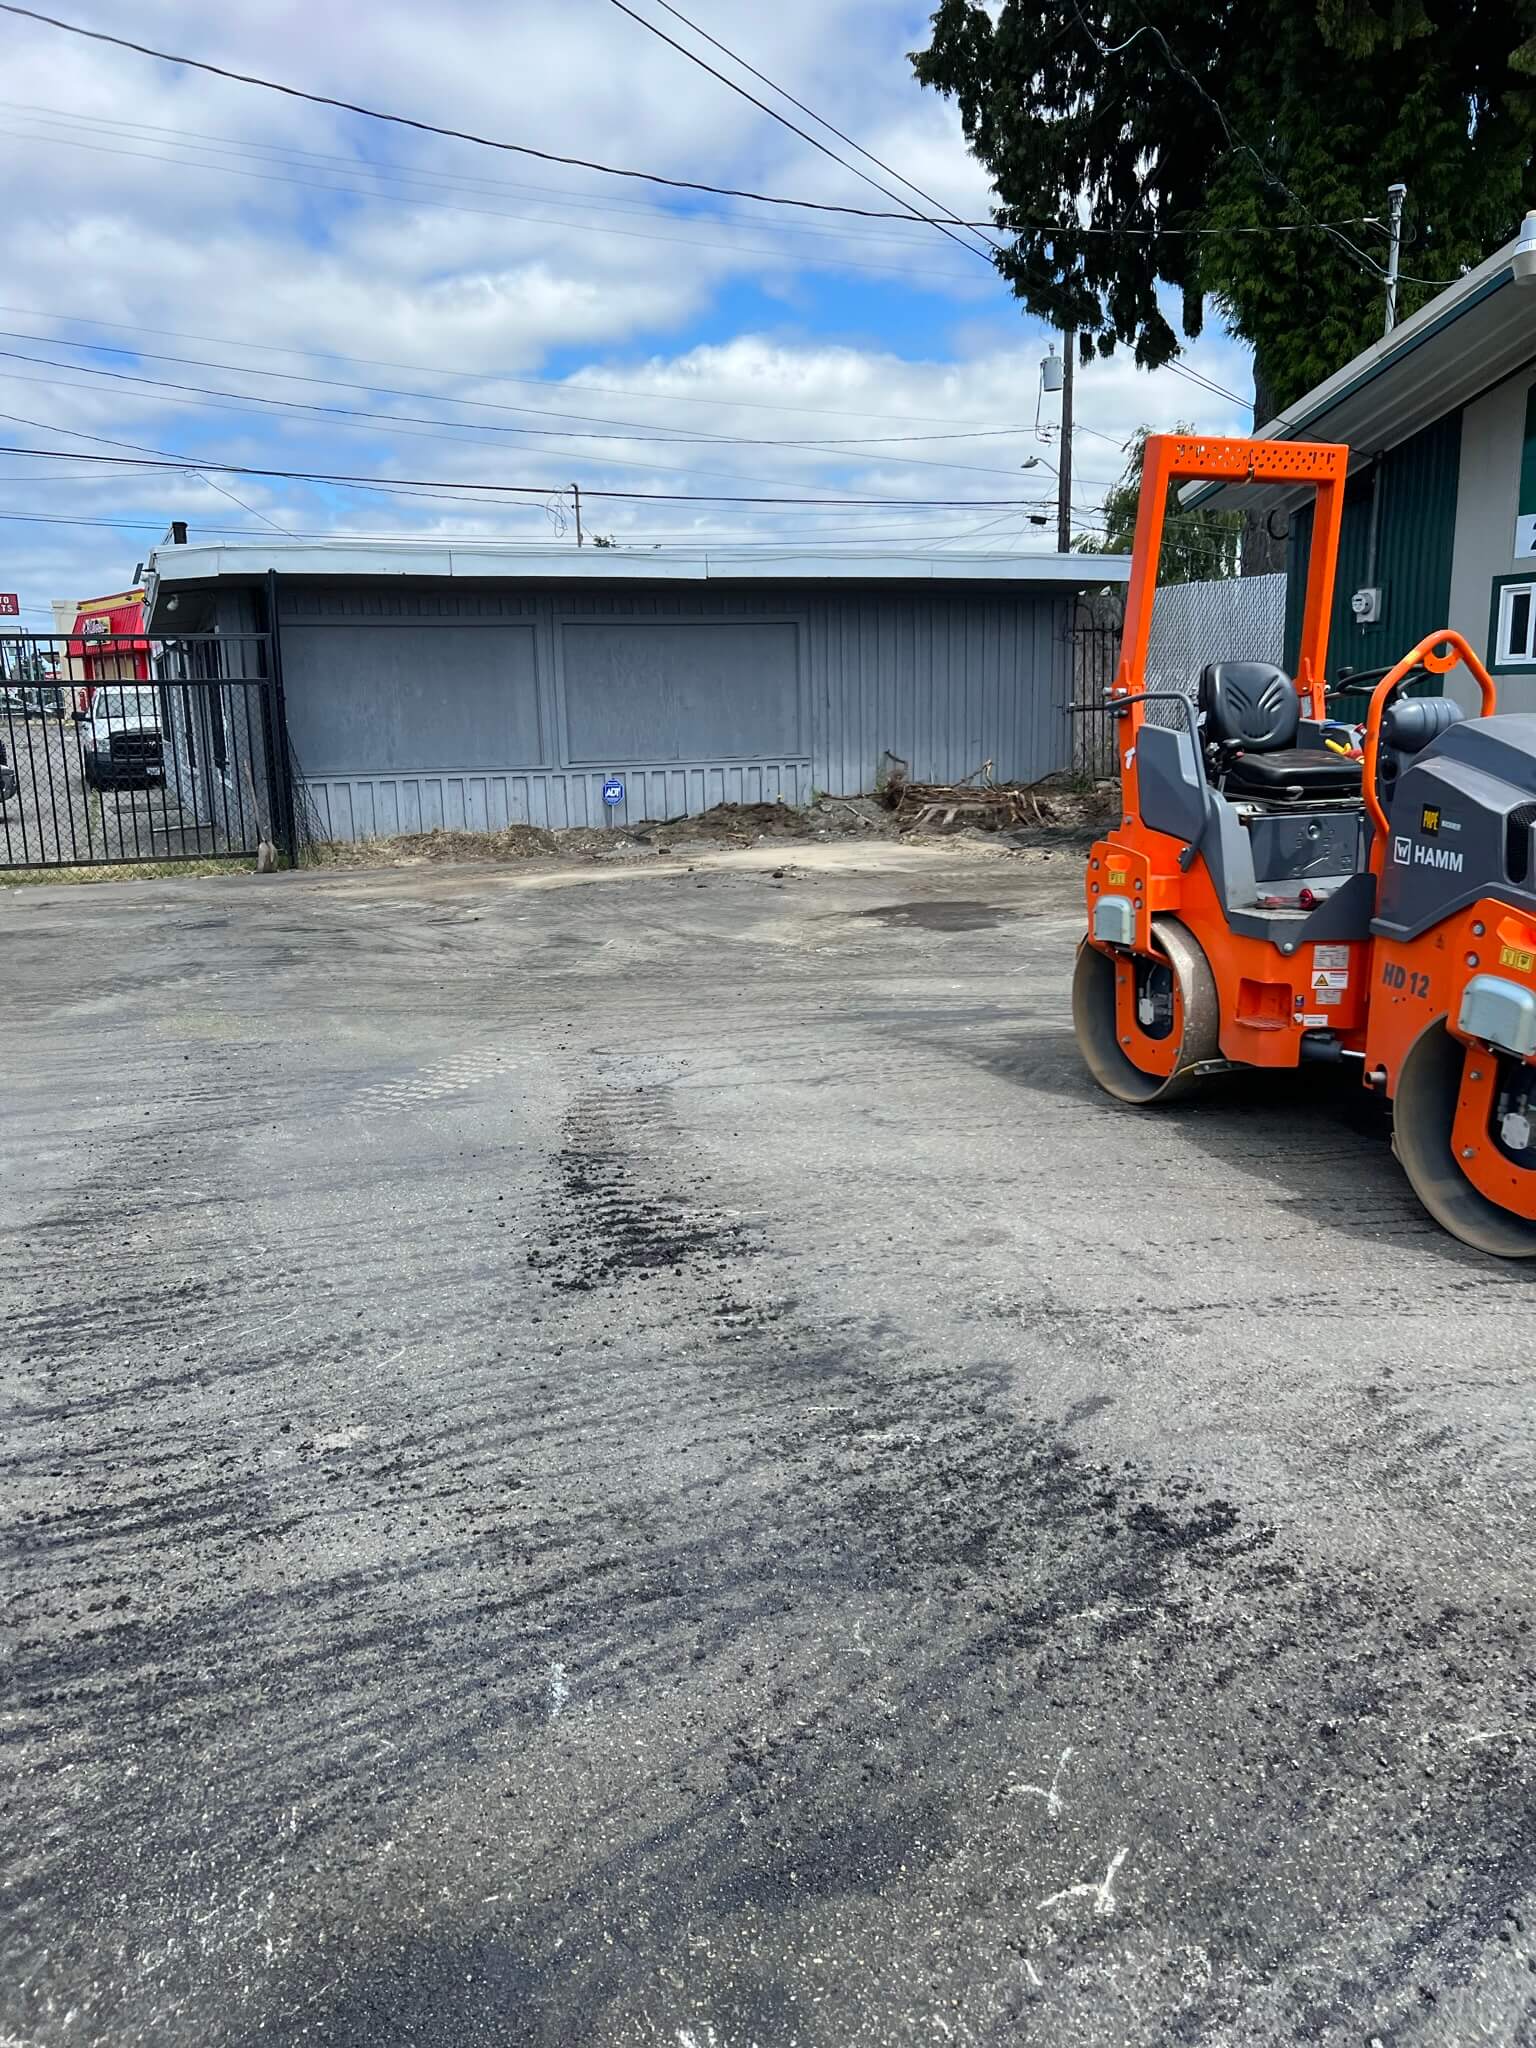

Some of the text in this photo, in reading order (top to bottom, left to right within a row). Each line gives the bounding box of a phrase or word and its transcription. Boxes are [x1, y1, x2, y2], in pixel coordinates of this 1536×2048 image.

[605, 787, 621, 797] ADT
[1414, 845, 1464, 873] HAMM
[1382, 961, 1430, 999] HD 12
